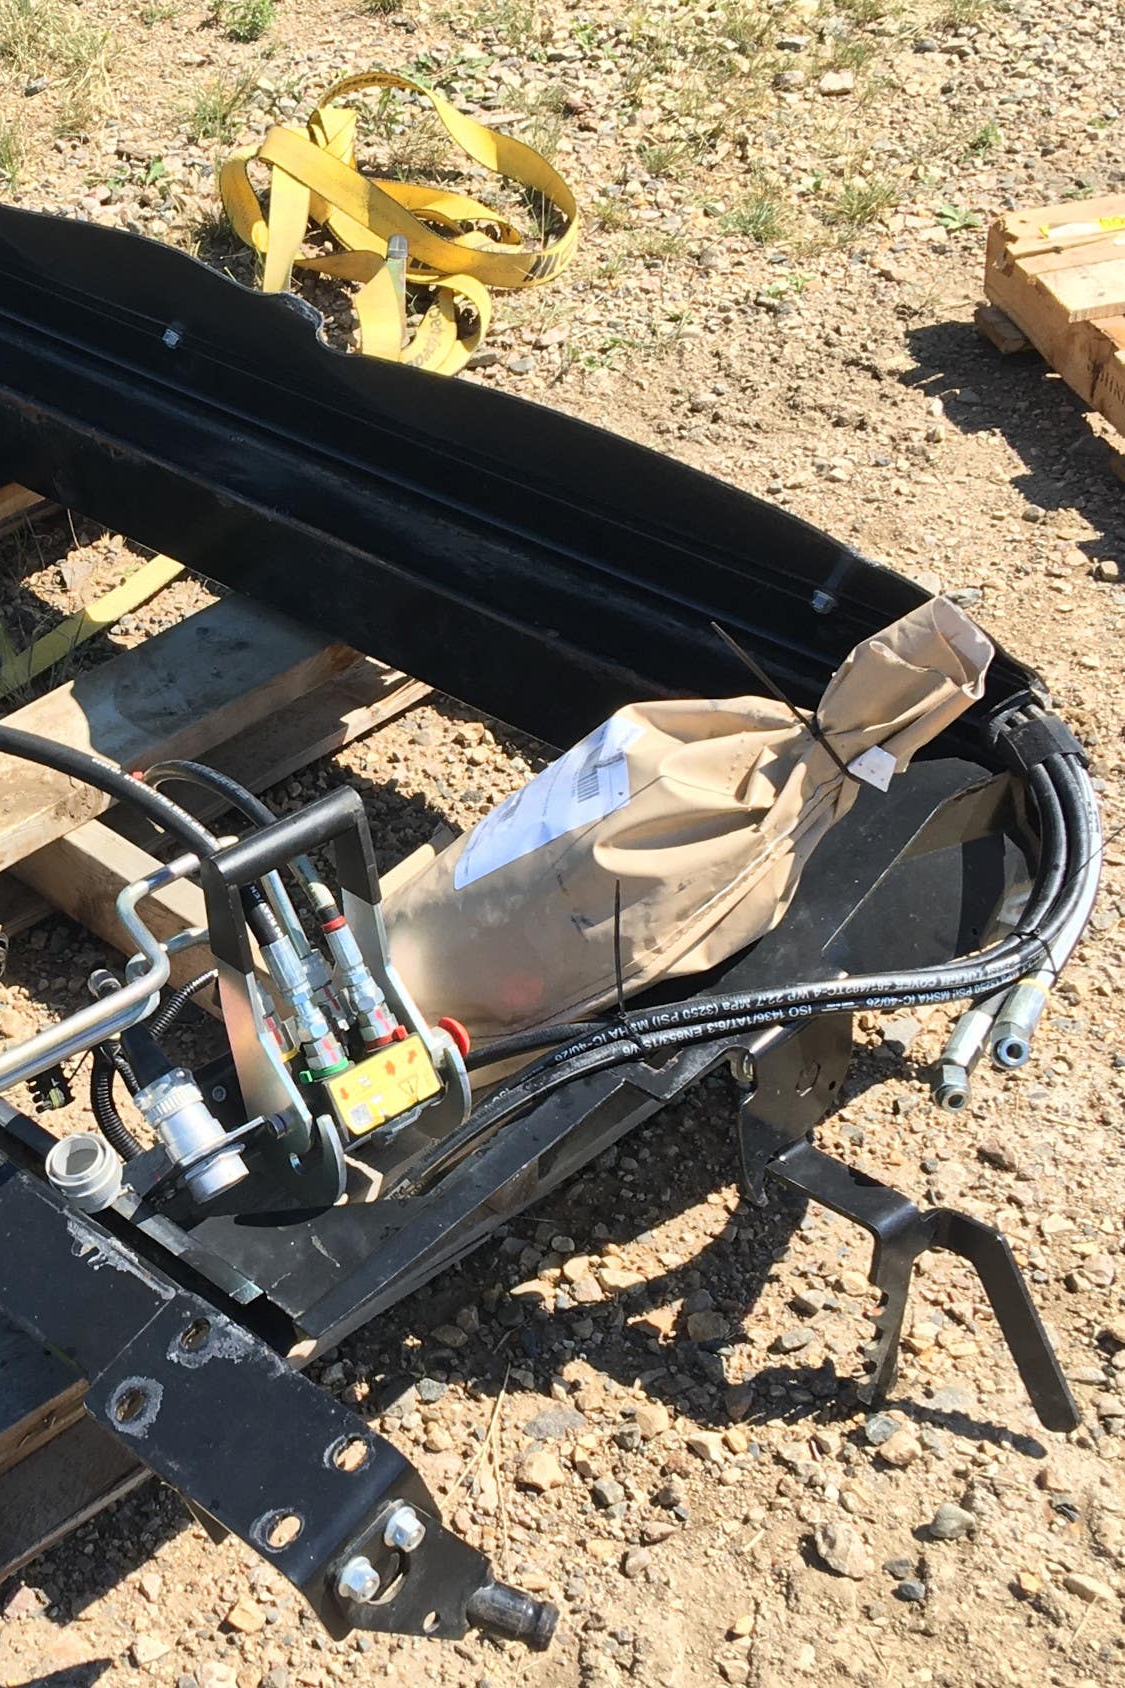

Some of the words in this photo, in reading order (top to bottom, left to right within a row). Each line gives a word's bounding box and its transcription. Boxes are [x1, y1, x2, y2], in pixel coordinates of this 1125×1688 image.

[754, 992, 784, 1006] 22.7
[786, 988, 809, 1001] WP
[865, 994, 916, 1006] IC-40/26
[917, 990, 951, 1002] MSHA
[721, 997, 751, 1009] MPa
[681, 1002, 718, 1019] (3250
[787, 1004, 812, 1017] ISO
[651, 1011, 679, 1026] PSI)
[705, 1008, 784, 1032] 1436/1AT/6.3
